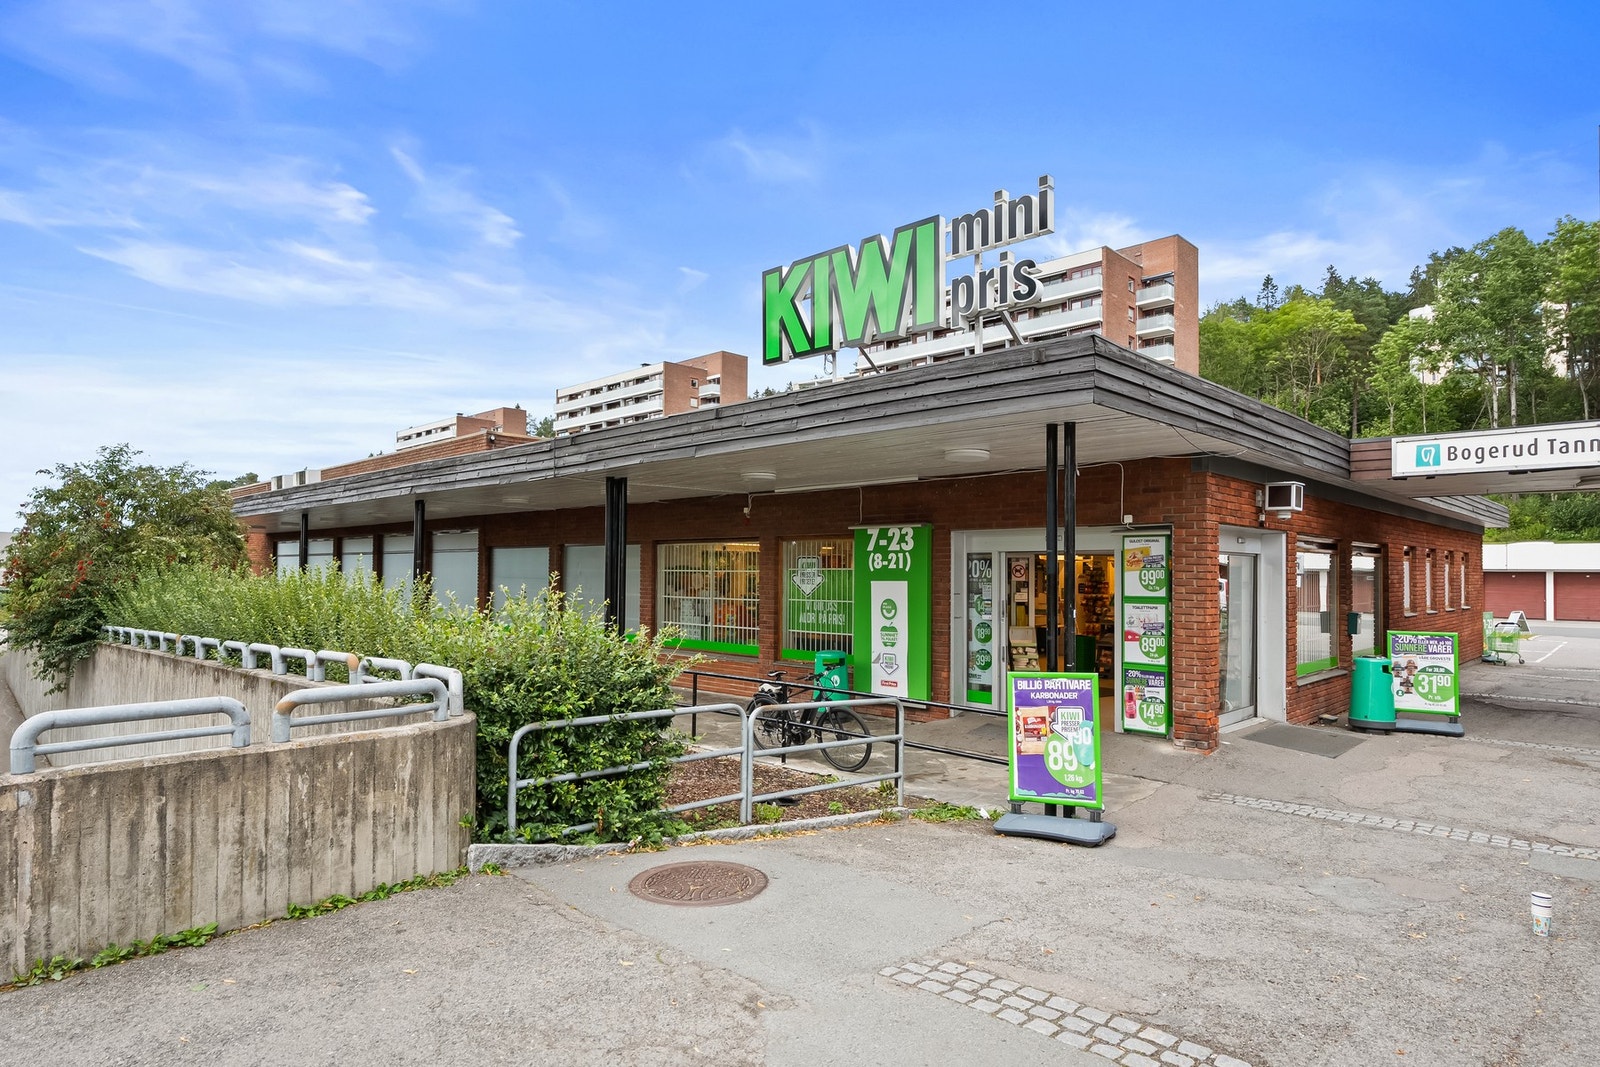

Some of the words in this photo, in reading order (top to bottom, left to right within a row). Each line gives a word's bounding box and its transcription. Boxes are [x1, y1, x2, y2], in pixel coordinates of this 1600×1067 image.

[951, 174, 1054, 255] mini
[762, 214, 943, 365] KIWI
[951, 250, 1044, 330] pris
[1447, 438, 1538, 464] Bogerud
[867, 527, 914, 551] 7-23
[868, 552, 911, 572] (8-21)
[1394, 642, 1427, 653] SUNNERE
[1428, 644, 1452, 654] VARER
[1017, 679, 1043, 690] BILLIG
[1044, 679, 1092, 690] PARTIVARE
[1030, 691, 1078, 700] KARBONADER
[1060, 711, 1080, 721] KIWI
